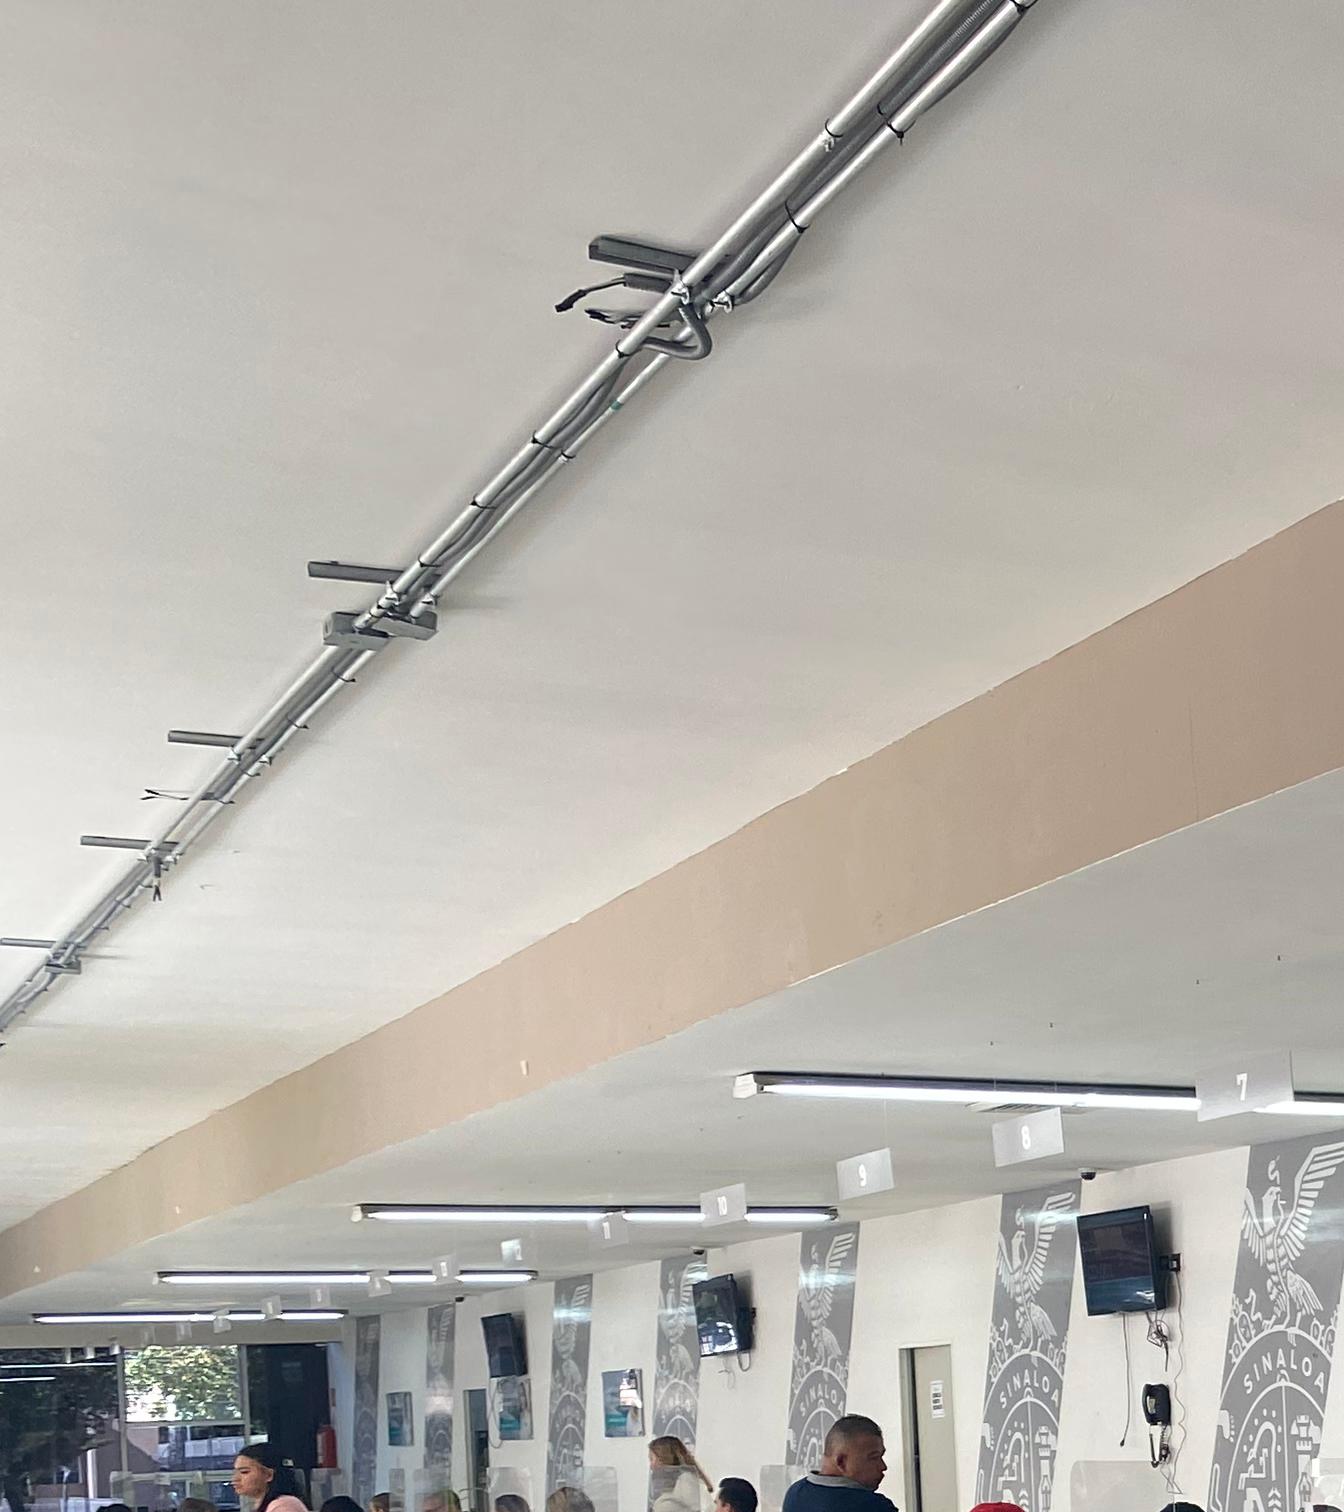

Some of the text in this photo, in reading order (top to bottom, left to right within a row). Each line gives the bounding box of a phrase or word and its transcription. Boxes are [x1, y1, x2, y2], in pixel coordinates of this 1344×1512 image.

[1236, 1072, 1247, 1101] 7
[1021, 1125, 1032, 1150] 8
[858, 1164, 867, 1187] 9
[1243, 1347, 1325, 1395] SINALOA
[999, 1368, 1060, 1409] SINALOA
